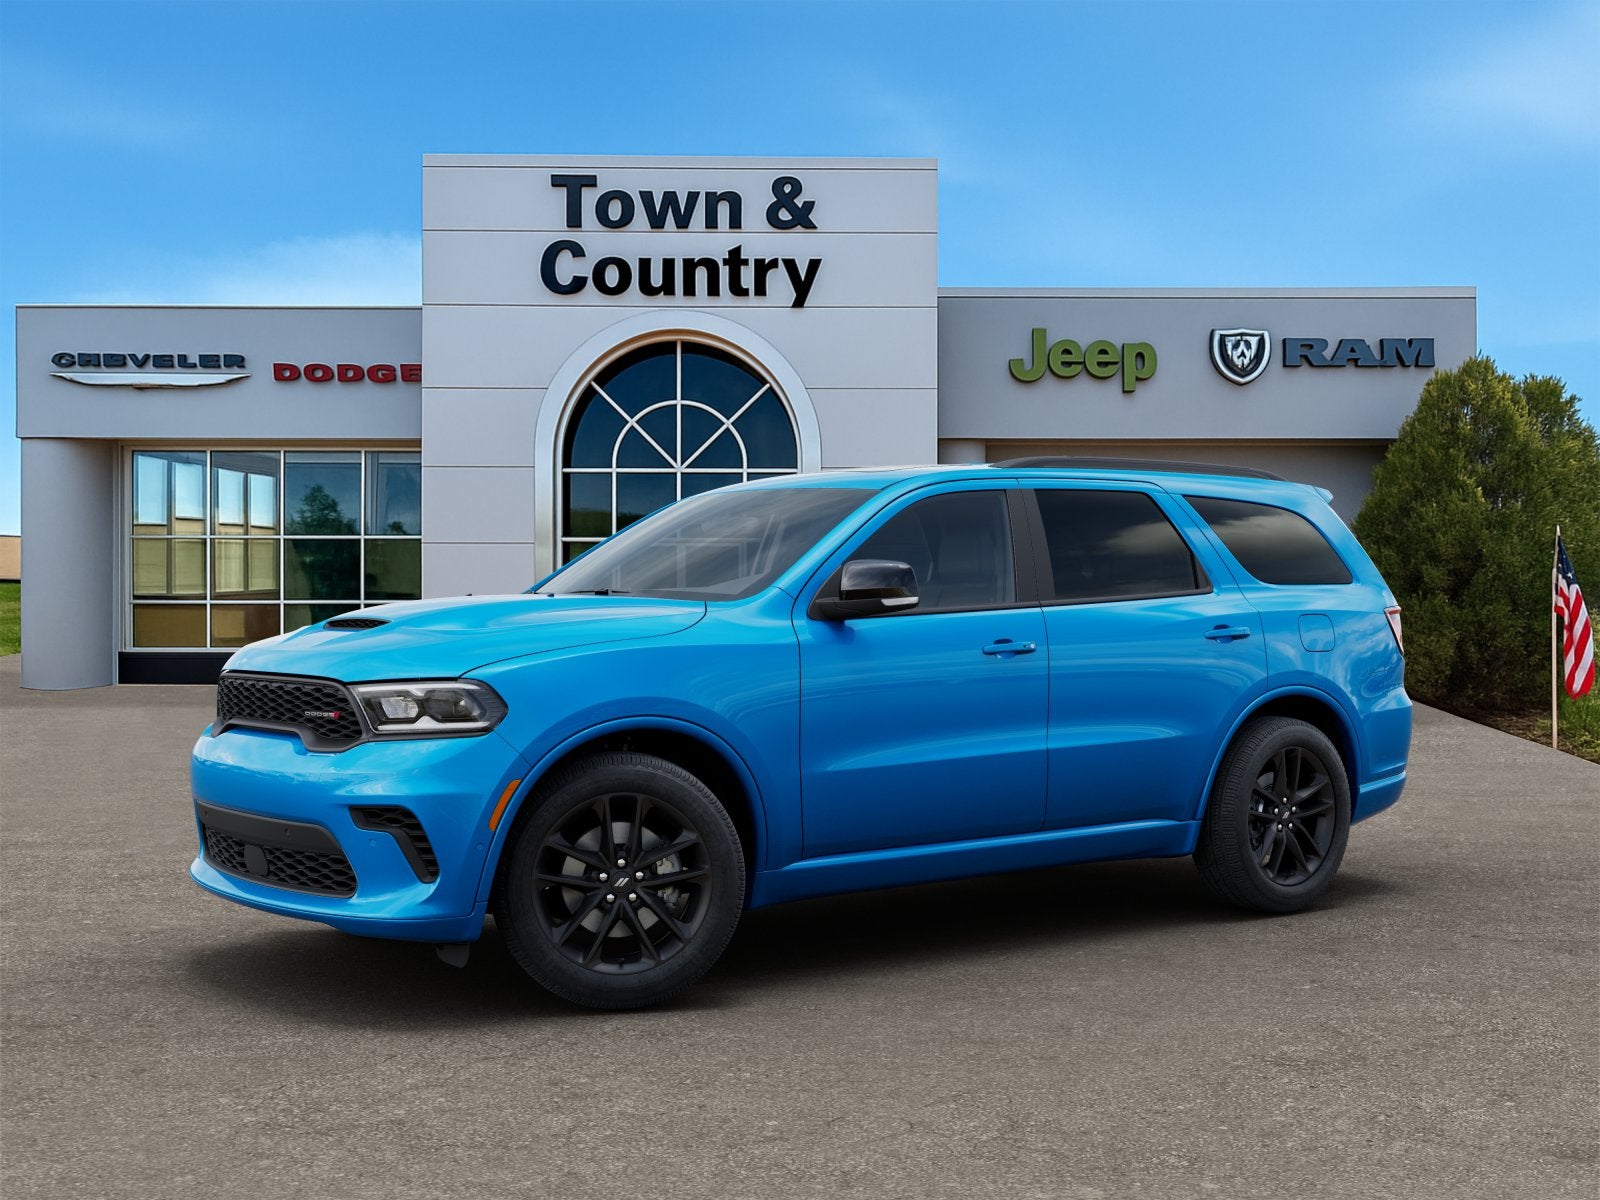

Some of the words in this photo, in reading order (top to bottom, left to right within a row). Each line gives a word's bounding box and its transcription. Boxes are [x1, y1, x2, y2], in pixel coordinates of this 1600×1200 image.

[550, 174, 743, 230] Town
[765, 176, 818, 230] &
[540, 239, 823, 308] Country
[272, 362, 422, 383] DODGE
[1008, 328, 1158, 393] Jeep
[1282, 337, 1436, 368] RAM
